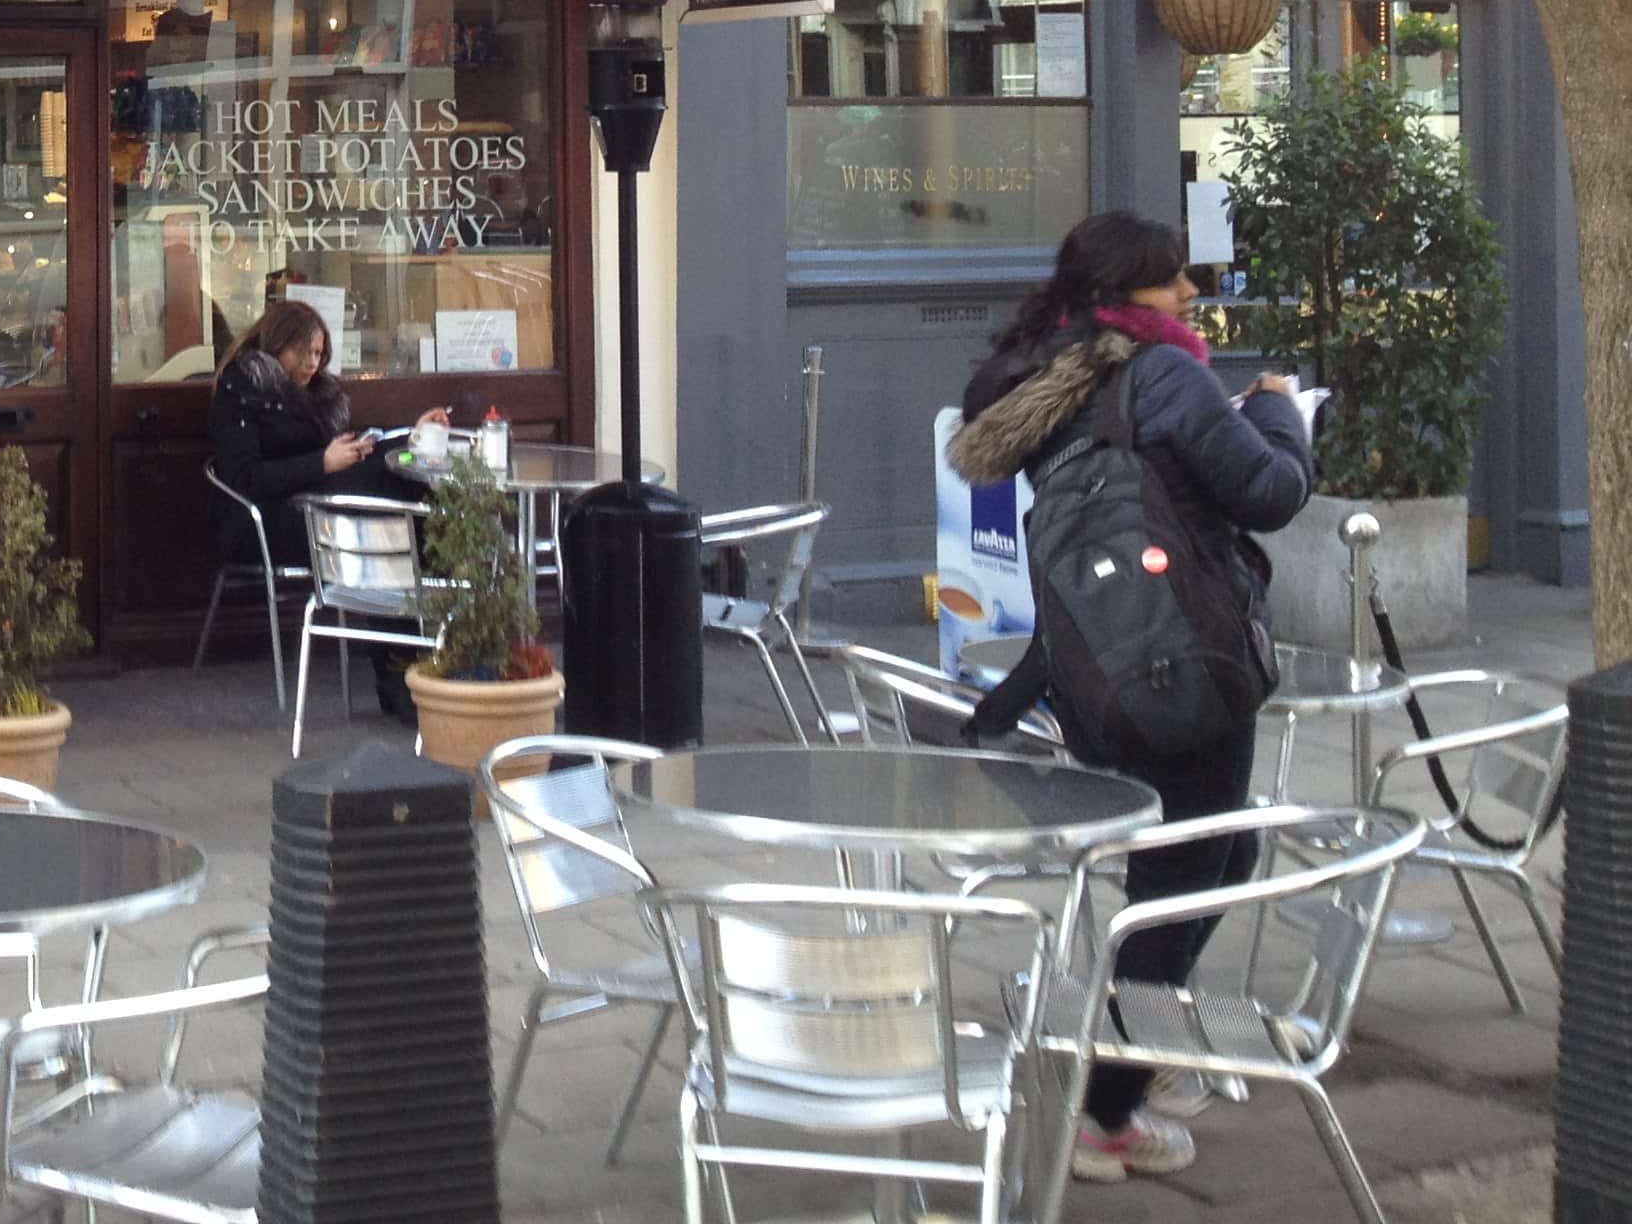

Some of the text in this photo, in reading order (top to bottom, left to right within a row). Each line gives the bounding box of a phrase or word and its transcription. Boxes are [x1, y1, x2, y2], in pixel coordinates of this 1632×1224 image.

[215, 98, 460, 136] HOT MEALS
[144, 136, 527, 178] JACKET POTATOES
[197, 176, 478, 216] SANDWICHES
[923, 167, 938, 192] &
[181, 214, 494, 256] TO TAKE AWAY
[972, 527, 1016, 553] LAVAZZA
